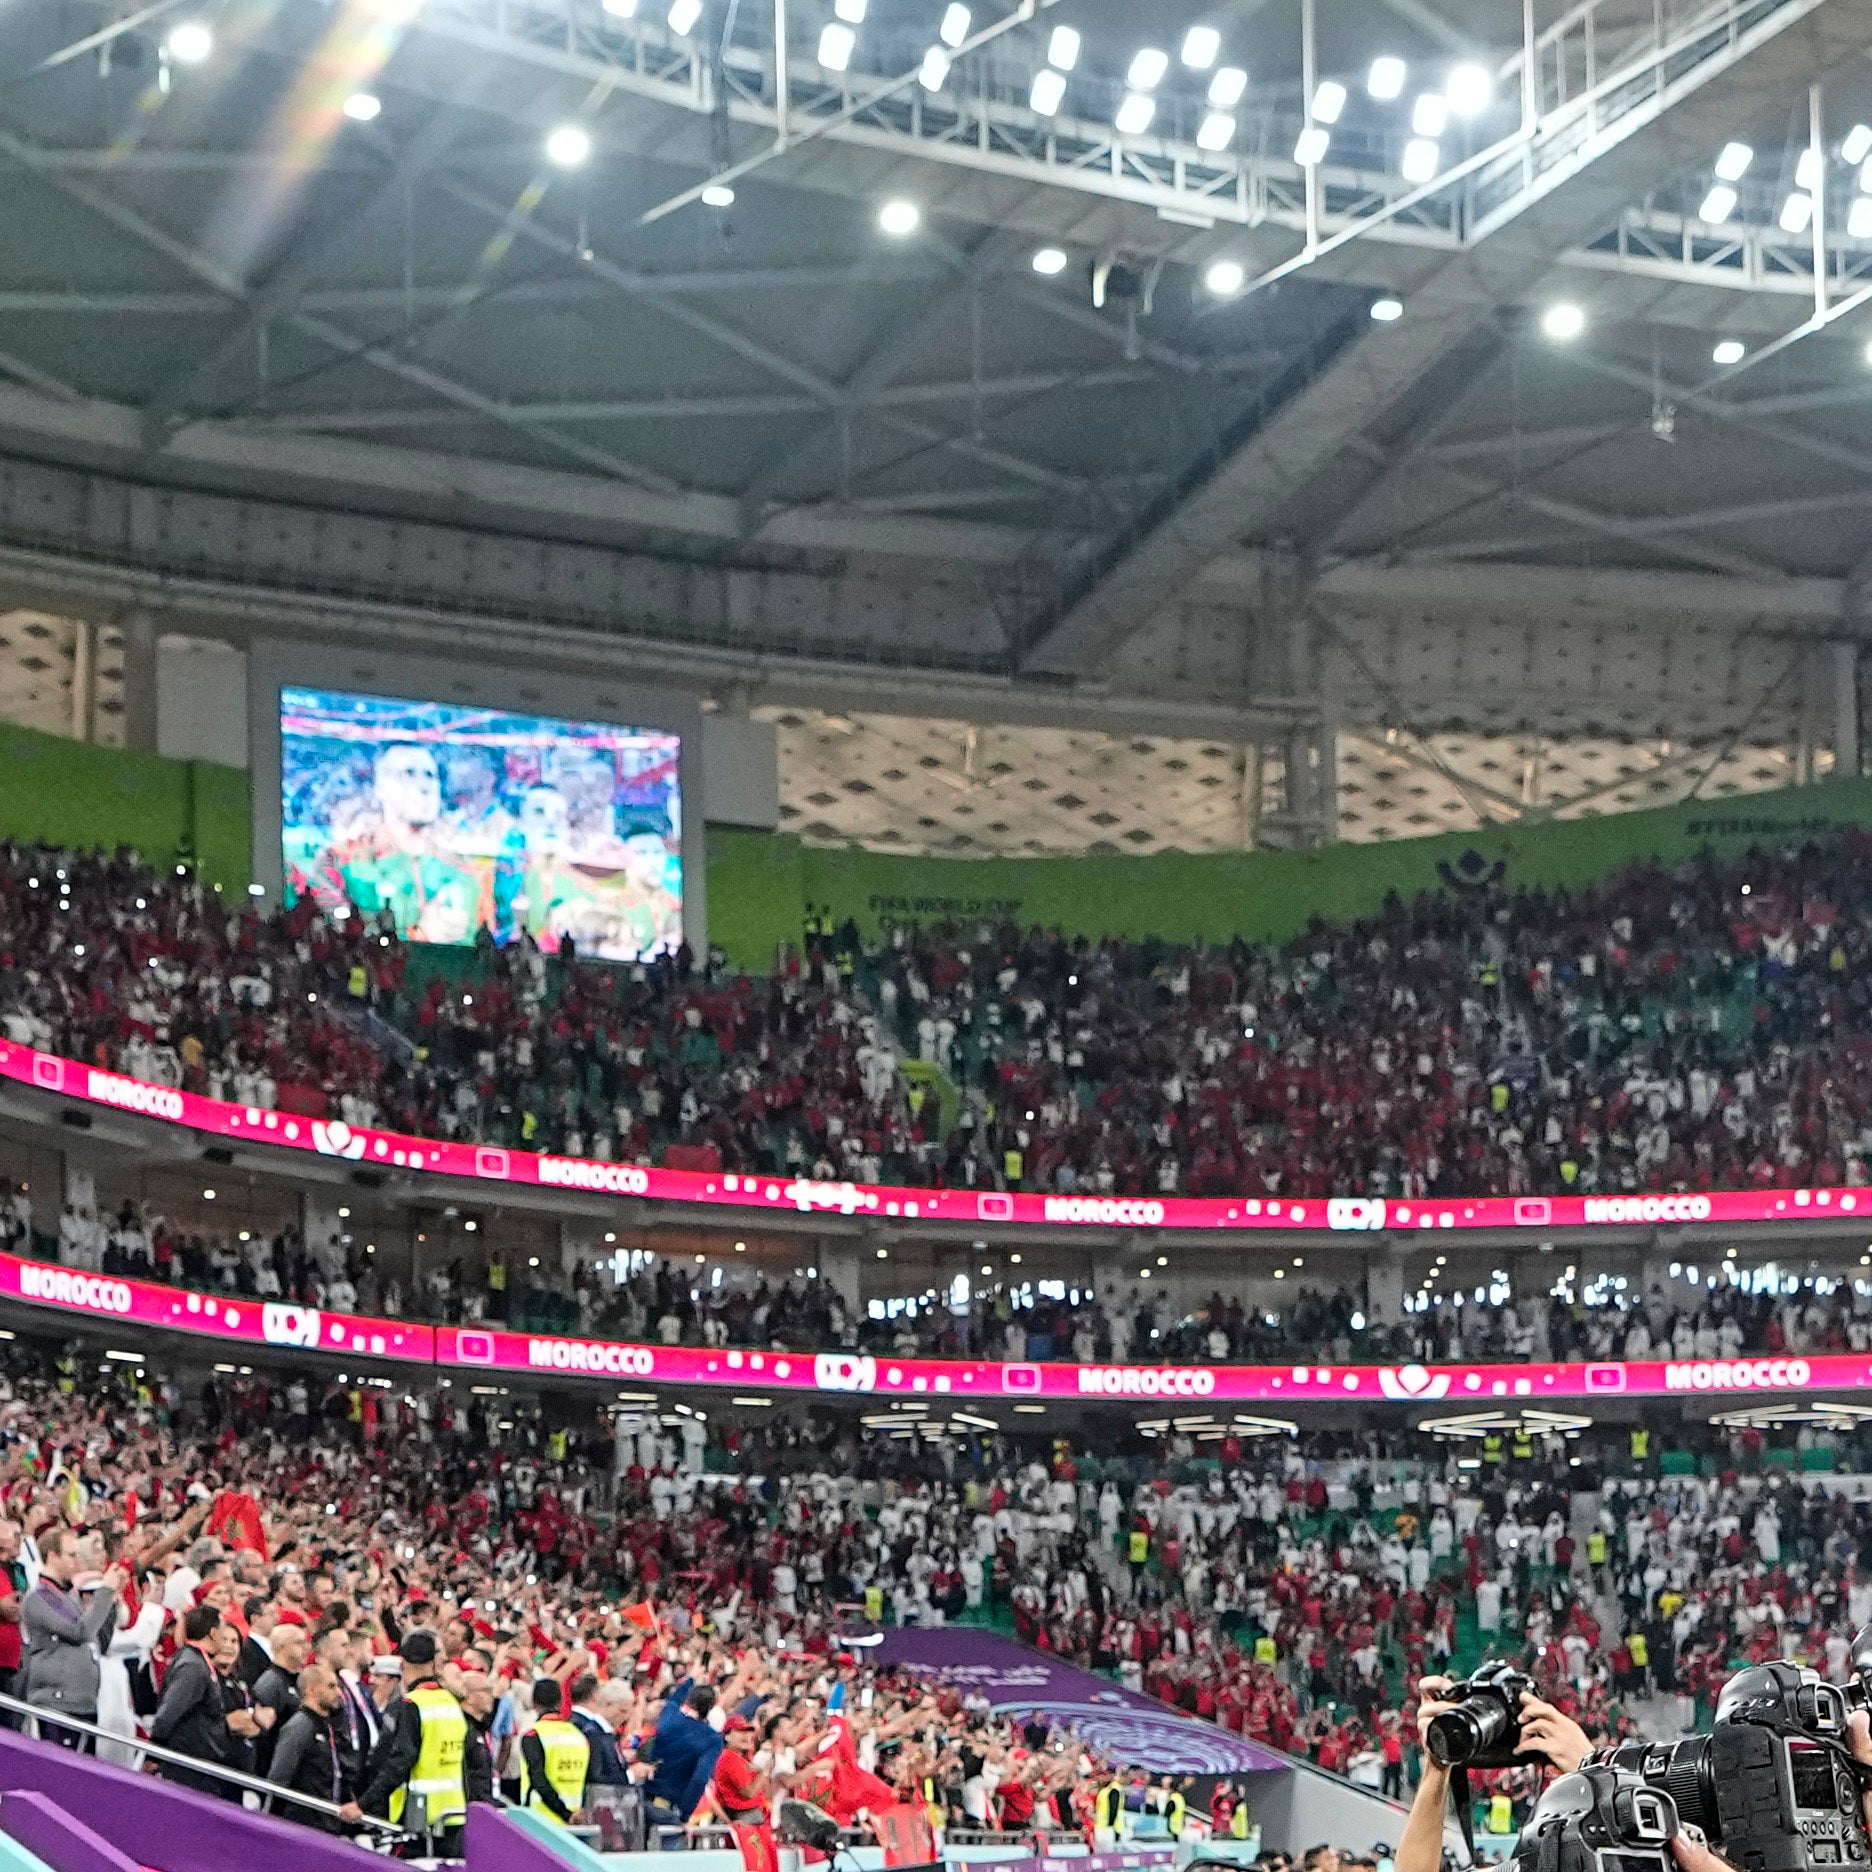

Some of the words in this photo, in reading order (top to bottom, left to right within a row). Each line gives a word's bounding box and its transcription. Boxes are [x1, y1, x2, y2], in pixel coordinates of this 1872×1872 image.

[87, 1069, 183, 1120] MOROCCO
[538, 1156, 649, 1195] MOROCCO
[1044, 1197, 1164, 1226] MOROCCO
[1584, 1195, 1711, 1222] MOROCCO
[20, 1262, 131, 1315] MOROCCO
[529, 1339, 654, 1375] MOROCCO
[1078, 1367, 1215, 1395] MOROCCO
[1665, 1360, 1811, 1390] MOROCCO
